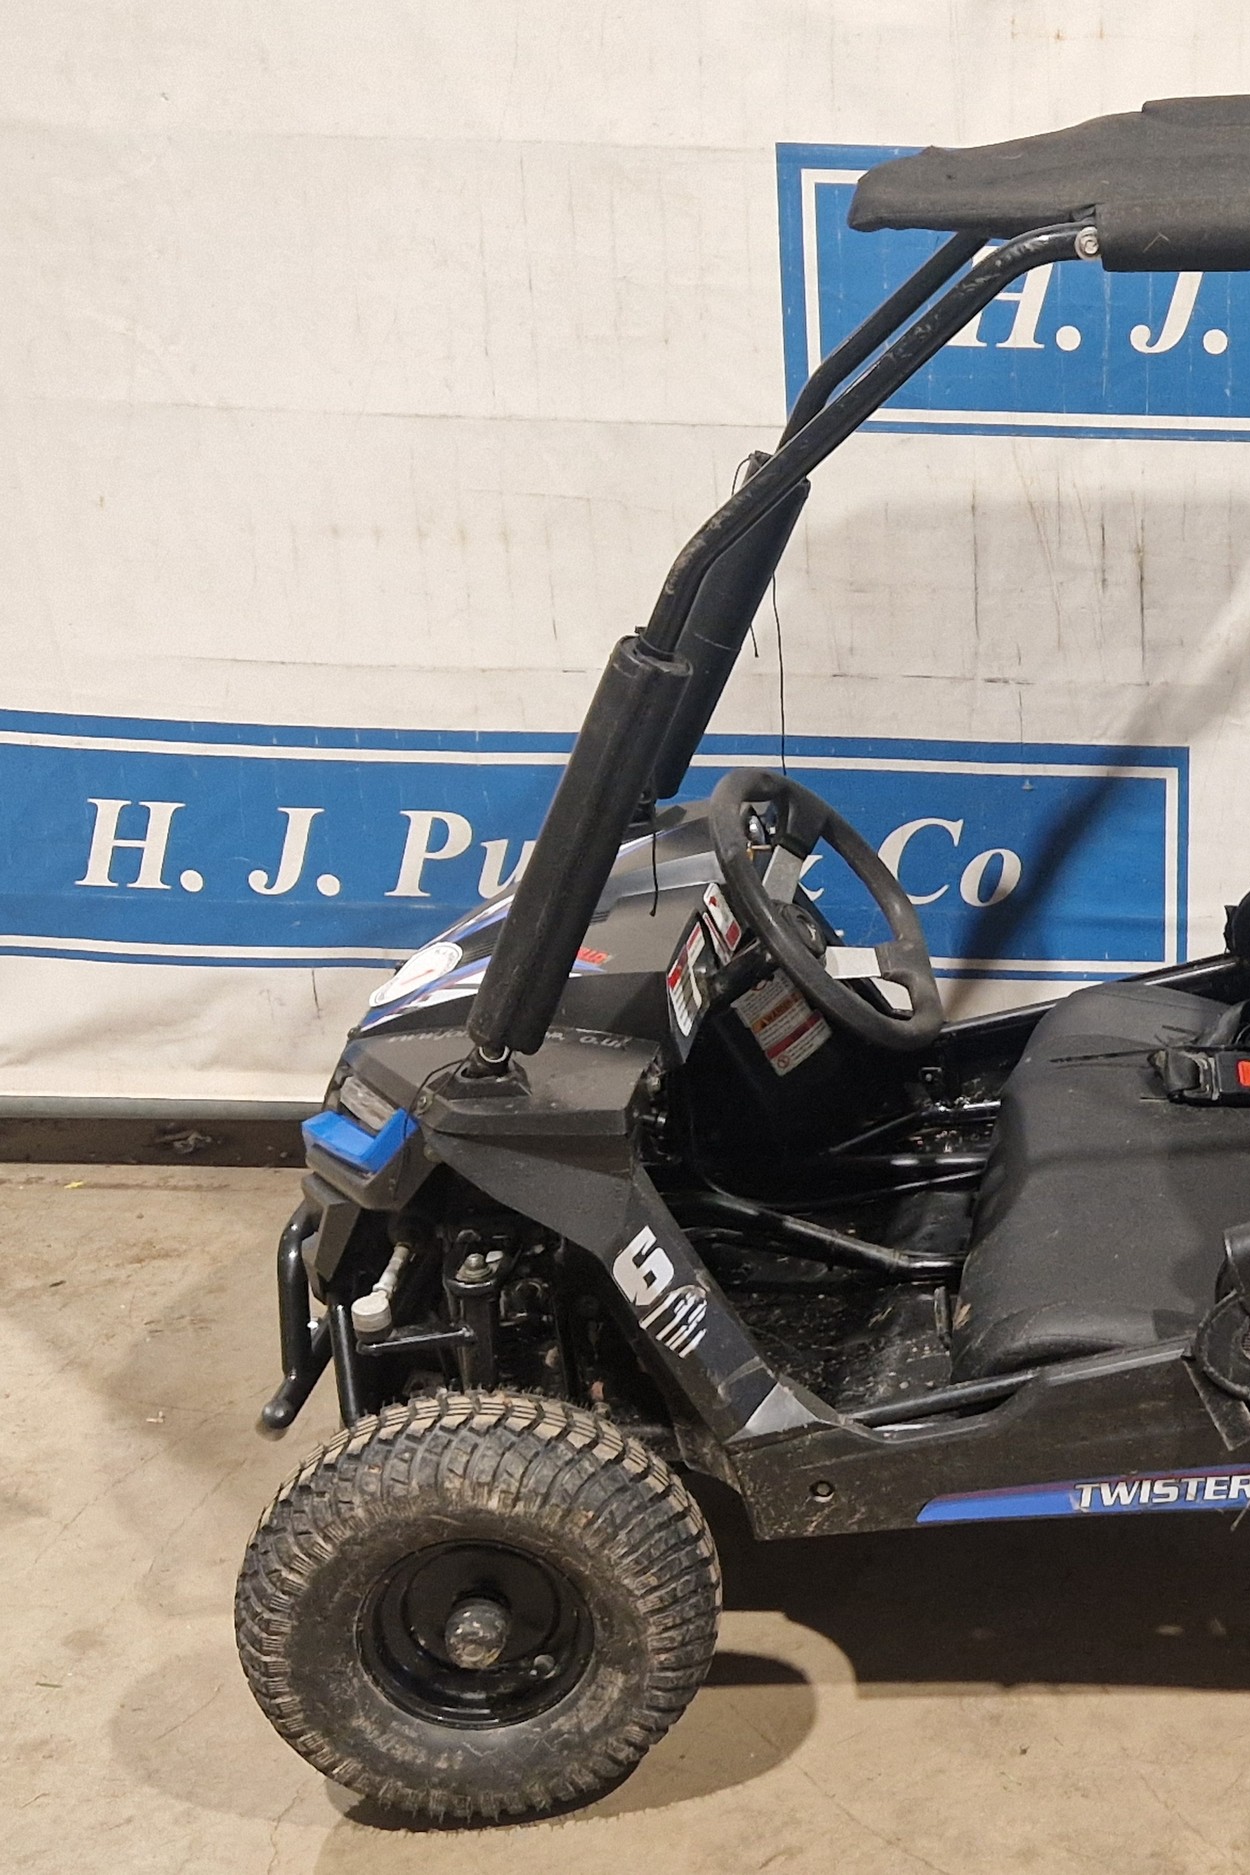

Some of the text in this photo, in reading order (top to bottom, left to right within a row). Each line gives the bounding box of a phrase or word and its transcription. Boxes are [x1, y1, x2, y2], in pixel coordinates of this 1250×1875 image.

[945, 245, 1082, 352] H.
[1130, 271, 1229, 355] J.
[75, 797, 537, 900] H. J. Pu
[877, 817, 1022, 907] Co
